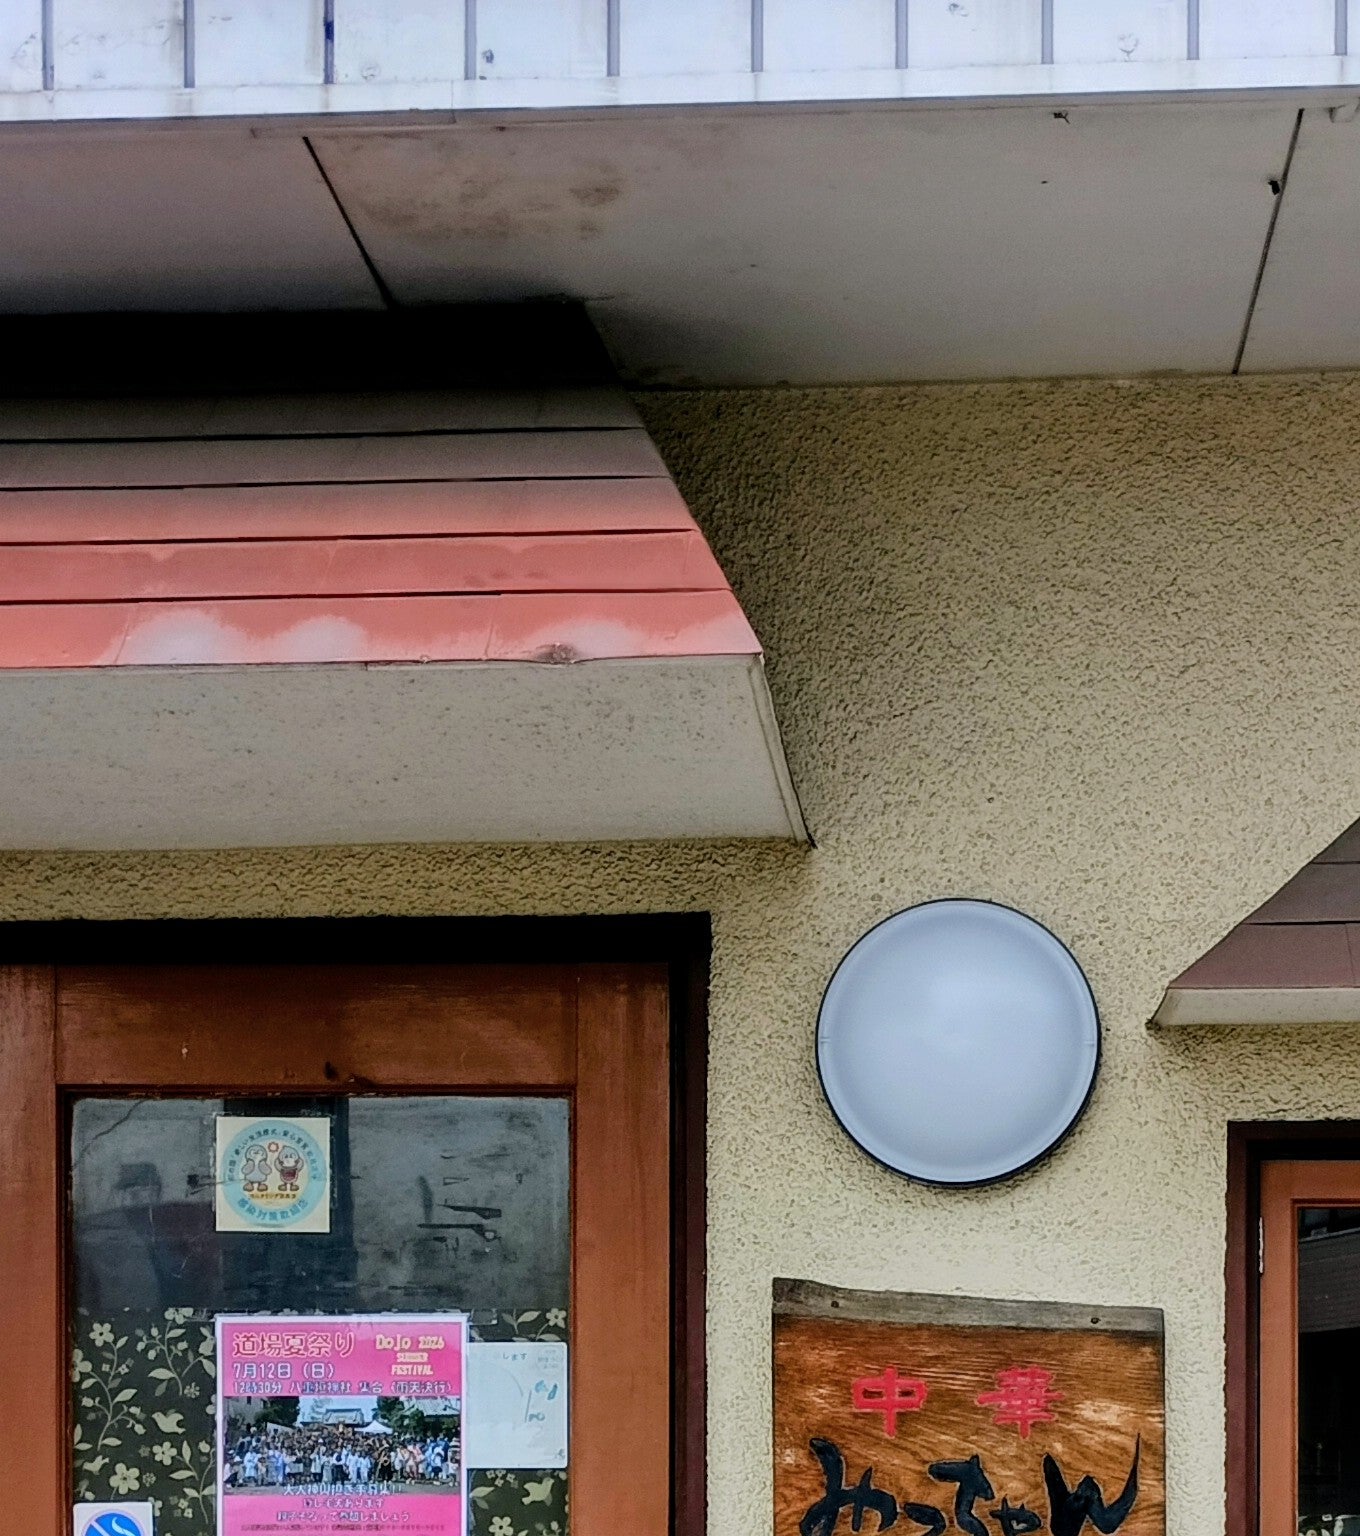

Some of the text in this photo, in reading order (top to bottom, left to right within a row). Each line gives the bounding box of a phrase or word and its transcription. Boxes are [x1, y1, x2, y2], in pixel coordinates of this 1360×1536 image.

[232, 1331, 357, 1359] 道場夏祭り
[391, 1364, 435, 1376] FESTIVAL
[849, 1364, 1067, 1440] 中華
